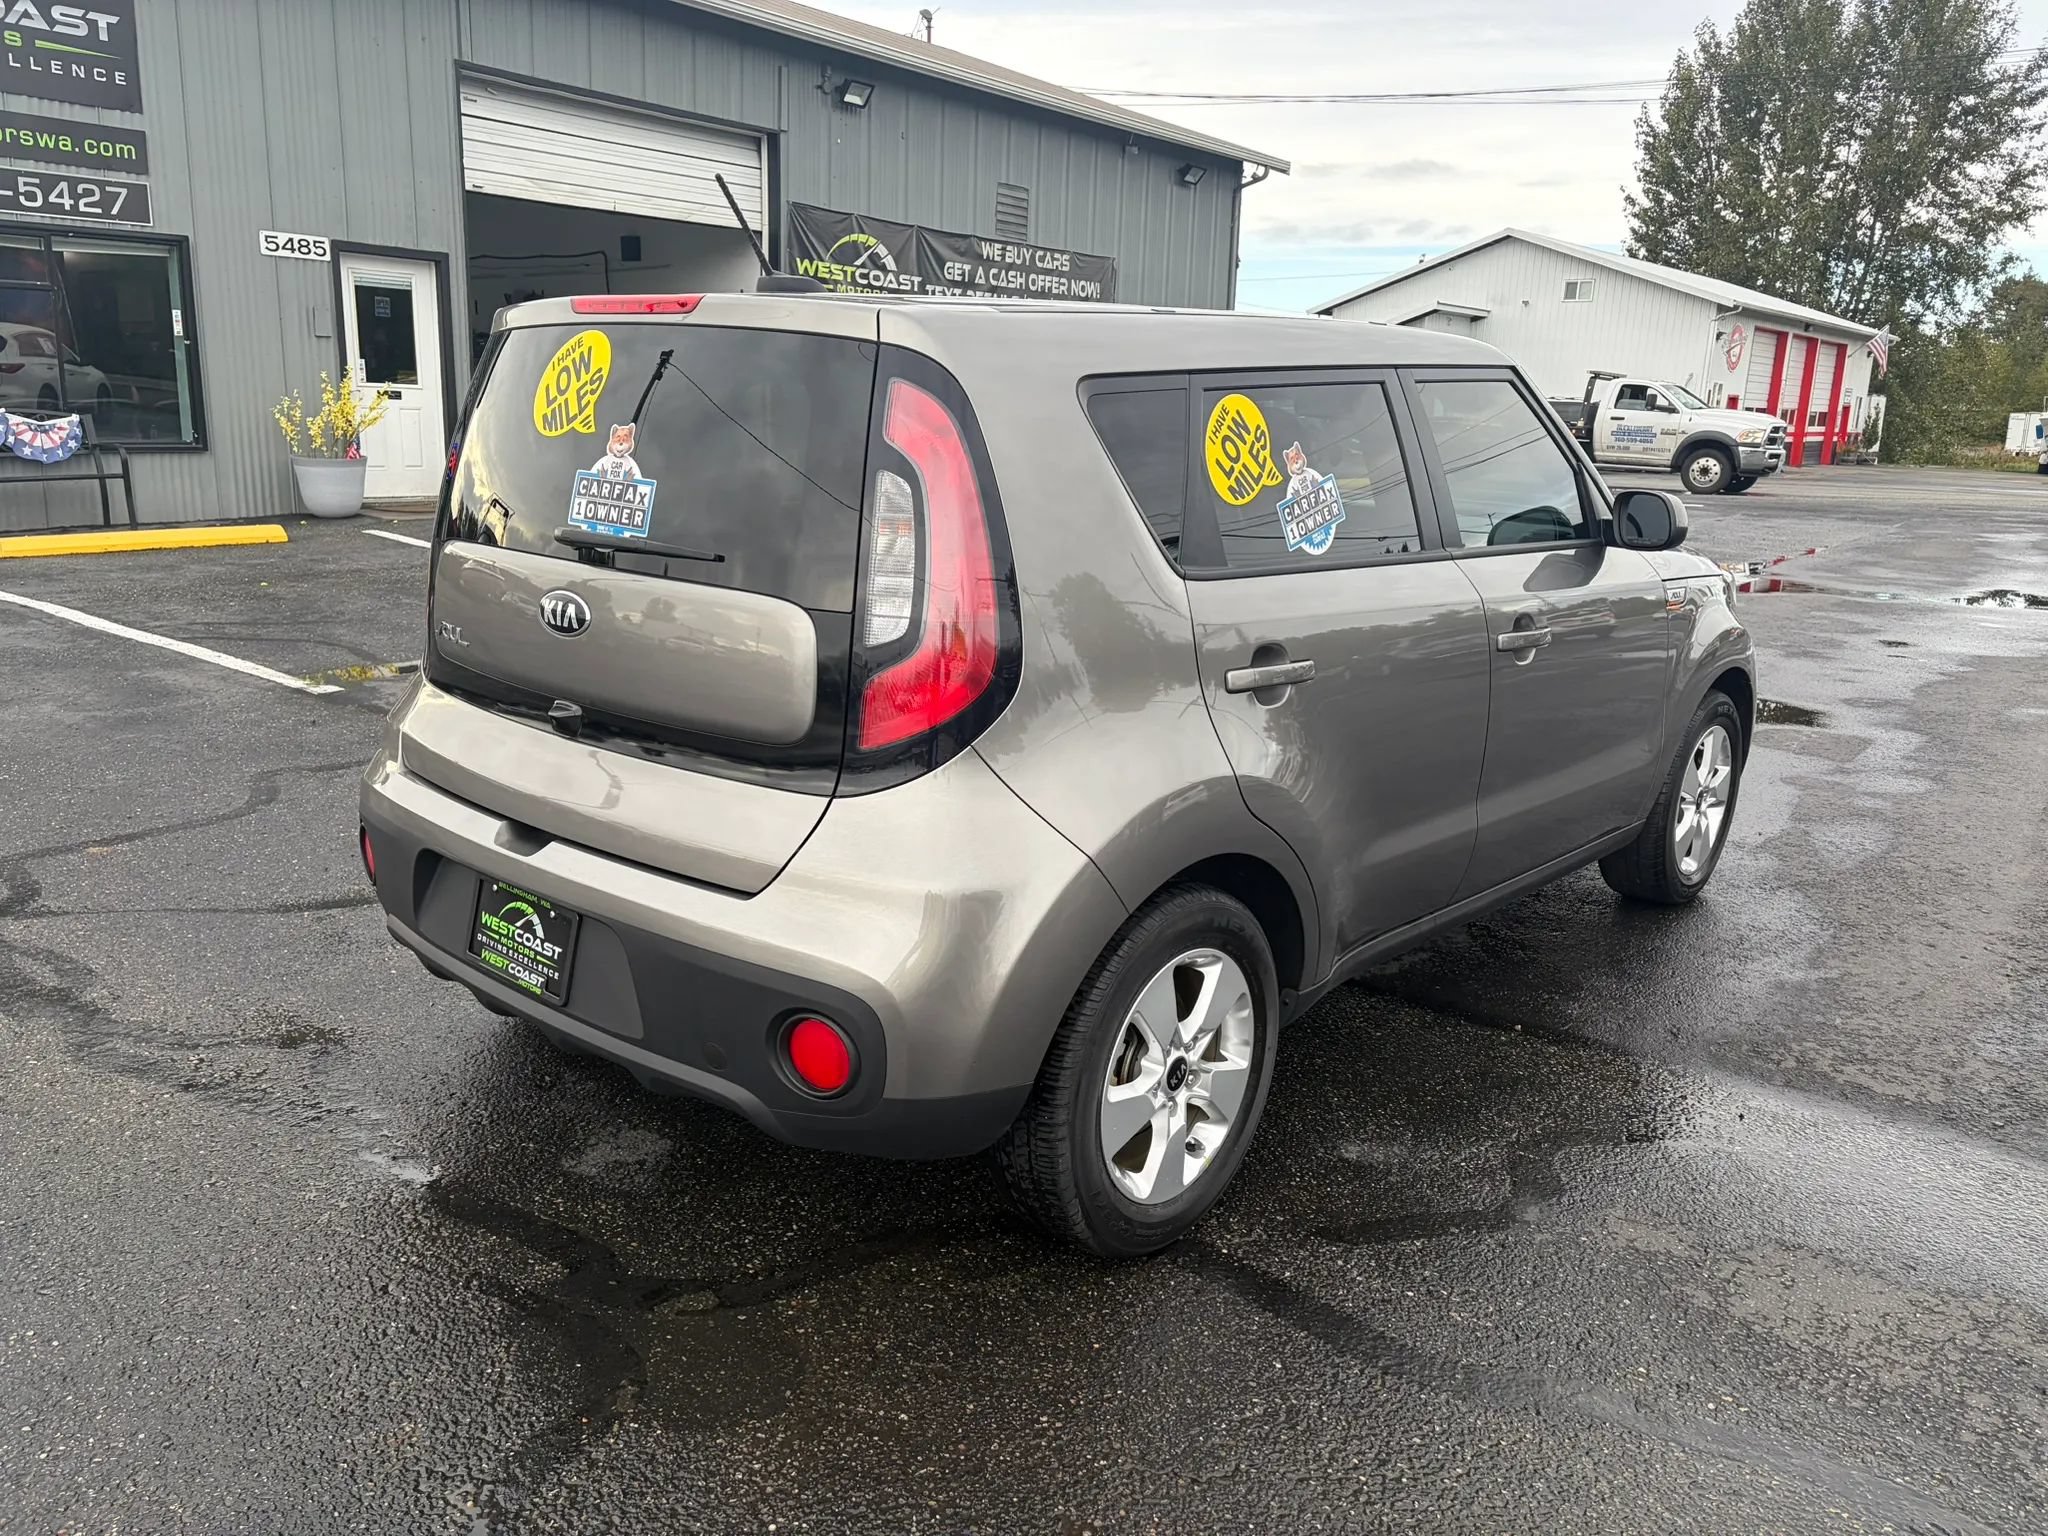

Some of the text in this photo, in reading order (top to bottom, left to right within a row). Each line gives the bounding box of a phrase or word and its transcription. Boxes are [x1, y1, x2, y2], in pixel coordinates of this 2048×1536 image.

[0, 0, 120, 41] AST
[8, 53, 127, 85] LLENCE
[0, 127, 136, 159] rswa.com
[264, 235, 327, 257] 5485
[981, 241, 1070, 271] WE BUY CARS
[796, 257, 922, 291] WESTCOAST
[944, 261, 971, 281] GET
[975, 266, 986, 284] A
[989, 268, 1026, 288] CASH
[1028, 273, 1068, 295] OFFER
[1071, 279, 1100, 299] NOW!
[557, 336, 584, 367] HAVE
[545, 345, 592, 408] LOW
[542, 367, 604, 432] MILES
[1211, 404, 1230, 439] HAVE
[1215, 409, 1251, 480] LOW
[610, 470, 621, 478] FOX
[611, 461, 623, 470] CAR
[1227, 424, 1267, 501] MILES
[579, 480, 647, 506] CARFAX
[1284, 487, 1335, 521] CARFAX
[542, 599, 579, 629] KIA
[481, 911, 563, 960] WESTCOAST
[501, 936, 535, 959] MOTORS
[477, 933, 560, 980] DRIVING EXCELLENCE
[481, 948, 545, 987] WESTCOAST
[517, 979, 542, 995] MOTORS
[1170, 1063, 1187, 1087] KIA
